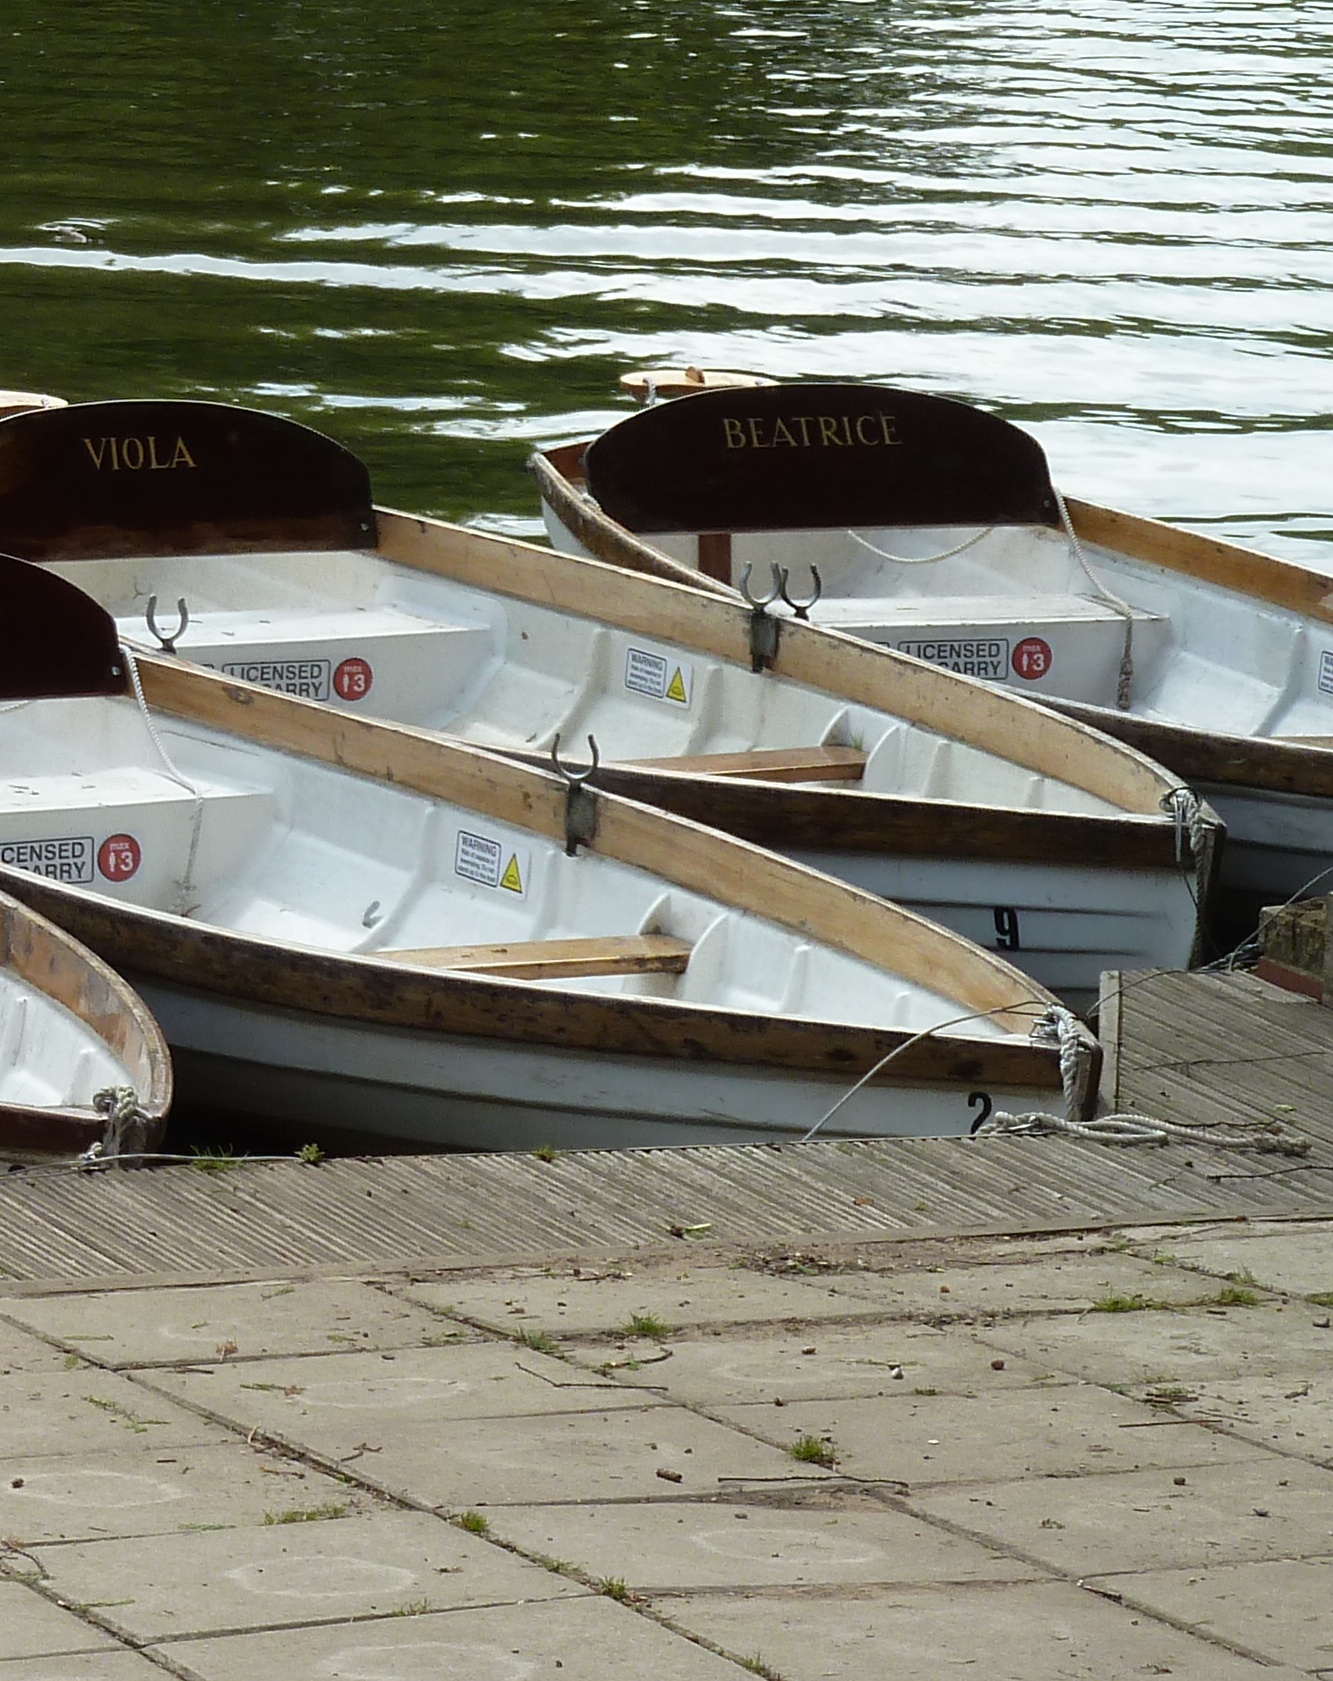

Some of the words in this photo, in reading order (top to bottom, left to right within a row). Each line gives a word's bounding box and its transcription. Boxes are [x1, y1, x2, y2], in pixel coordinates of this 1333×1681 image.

[722, 413, 903, 449] BEATRICE
[82, 436, 198, 471] VIOLA
[1032, 653, 1045, 671] 3
[353, 674, 366, 692] 3
[120, 852, 133, 871] 3
[994, 906, 1020, 950] 9
